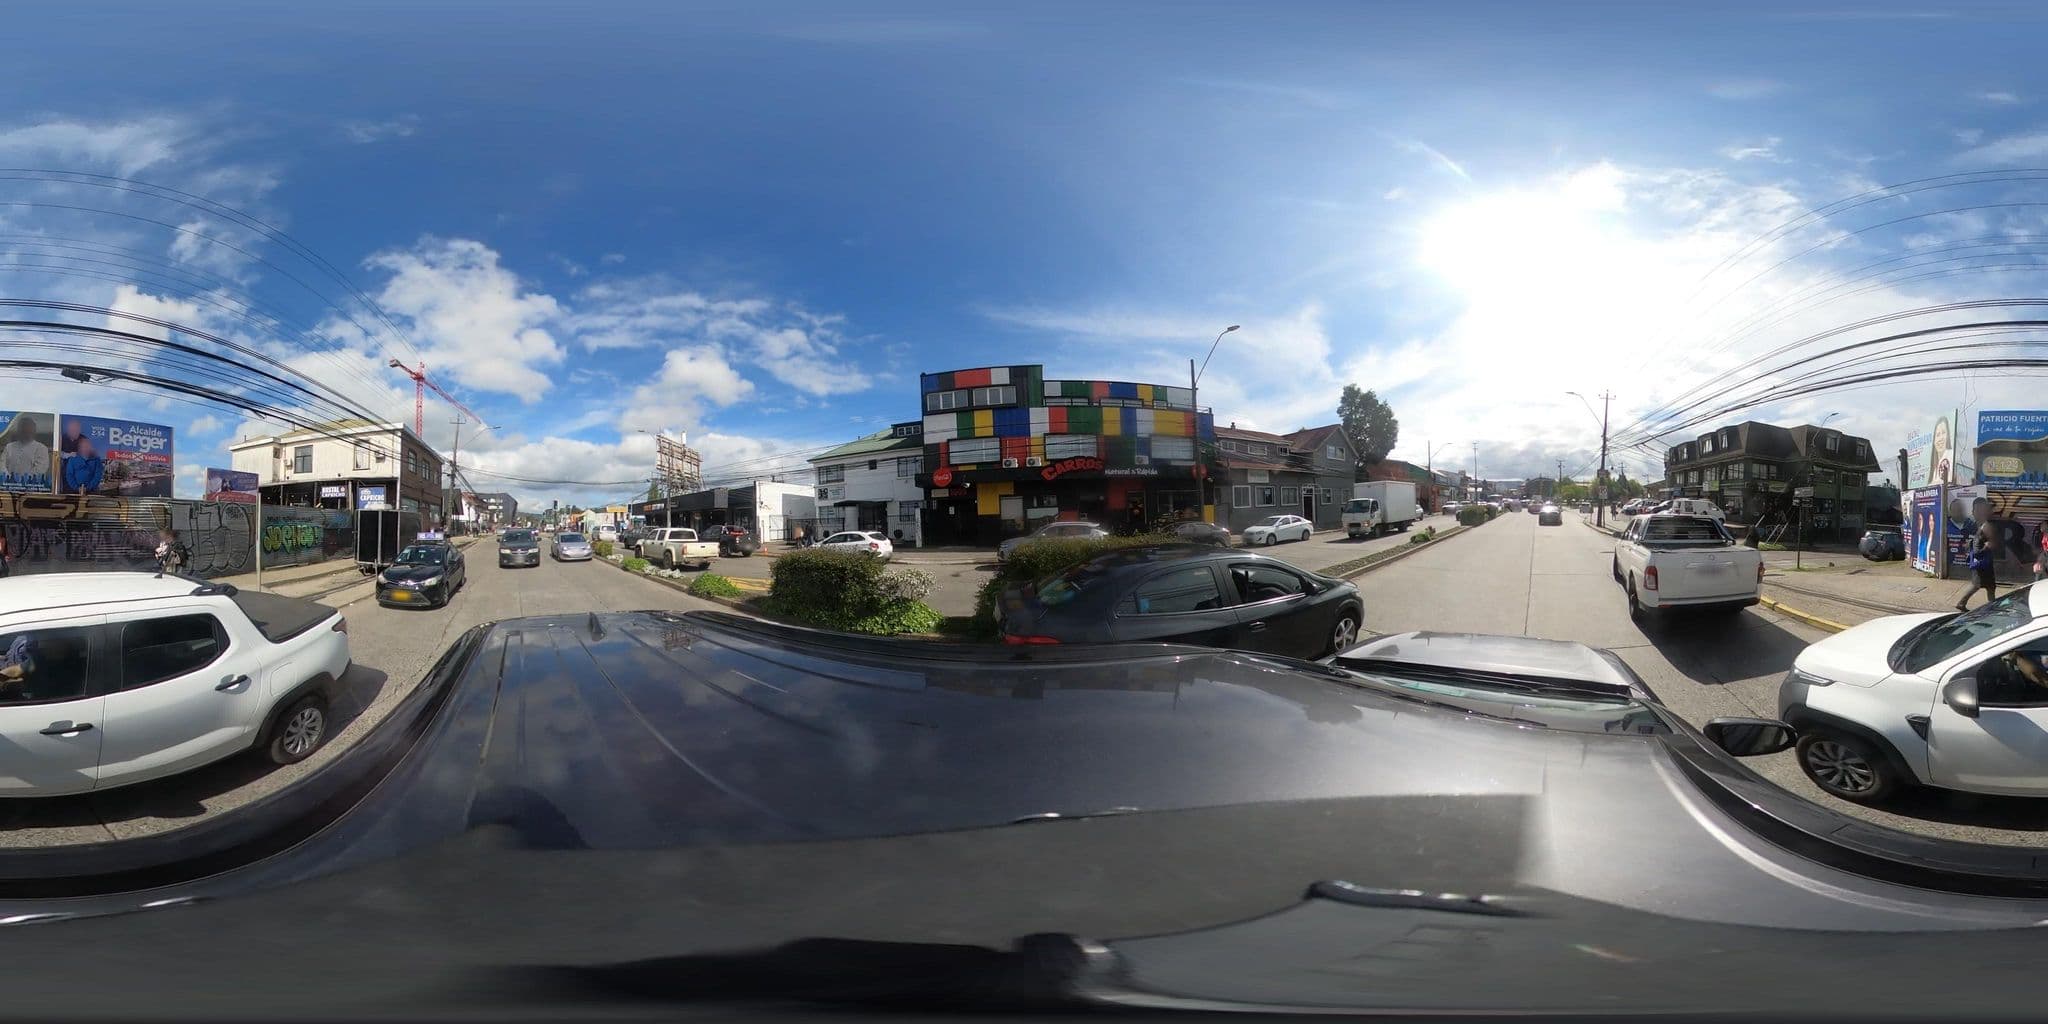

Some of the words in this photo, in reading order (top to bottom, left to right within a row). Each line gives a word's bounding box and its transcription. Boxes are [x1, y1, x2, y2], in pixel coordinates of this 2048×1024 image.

[109, 427, 167, 452] Berger
[129, 424, 161, 436] Alcalde
[1042, 457, 1104, 480] CARROS
